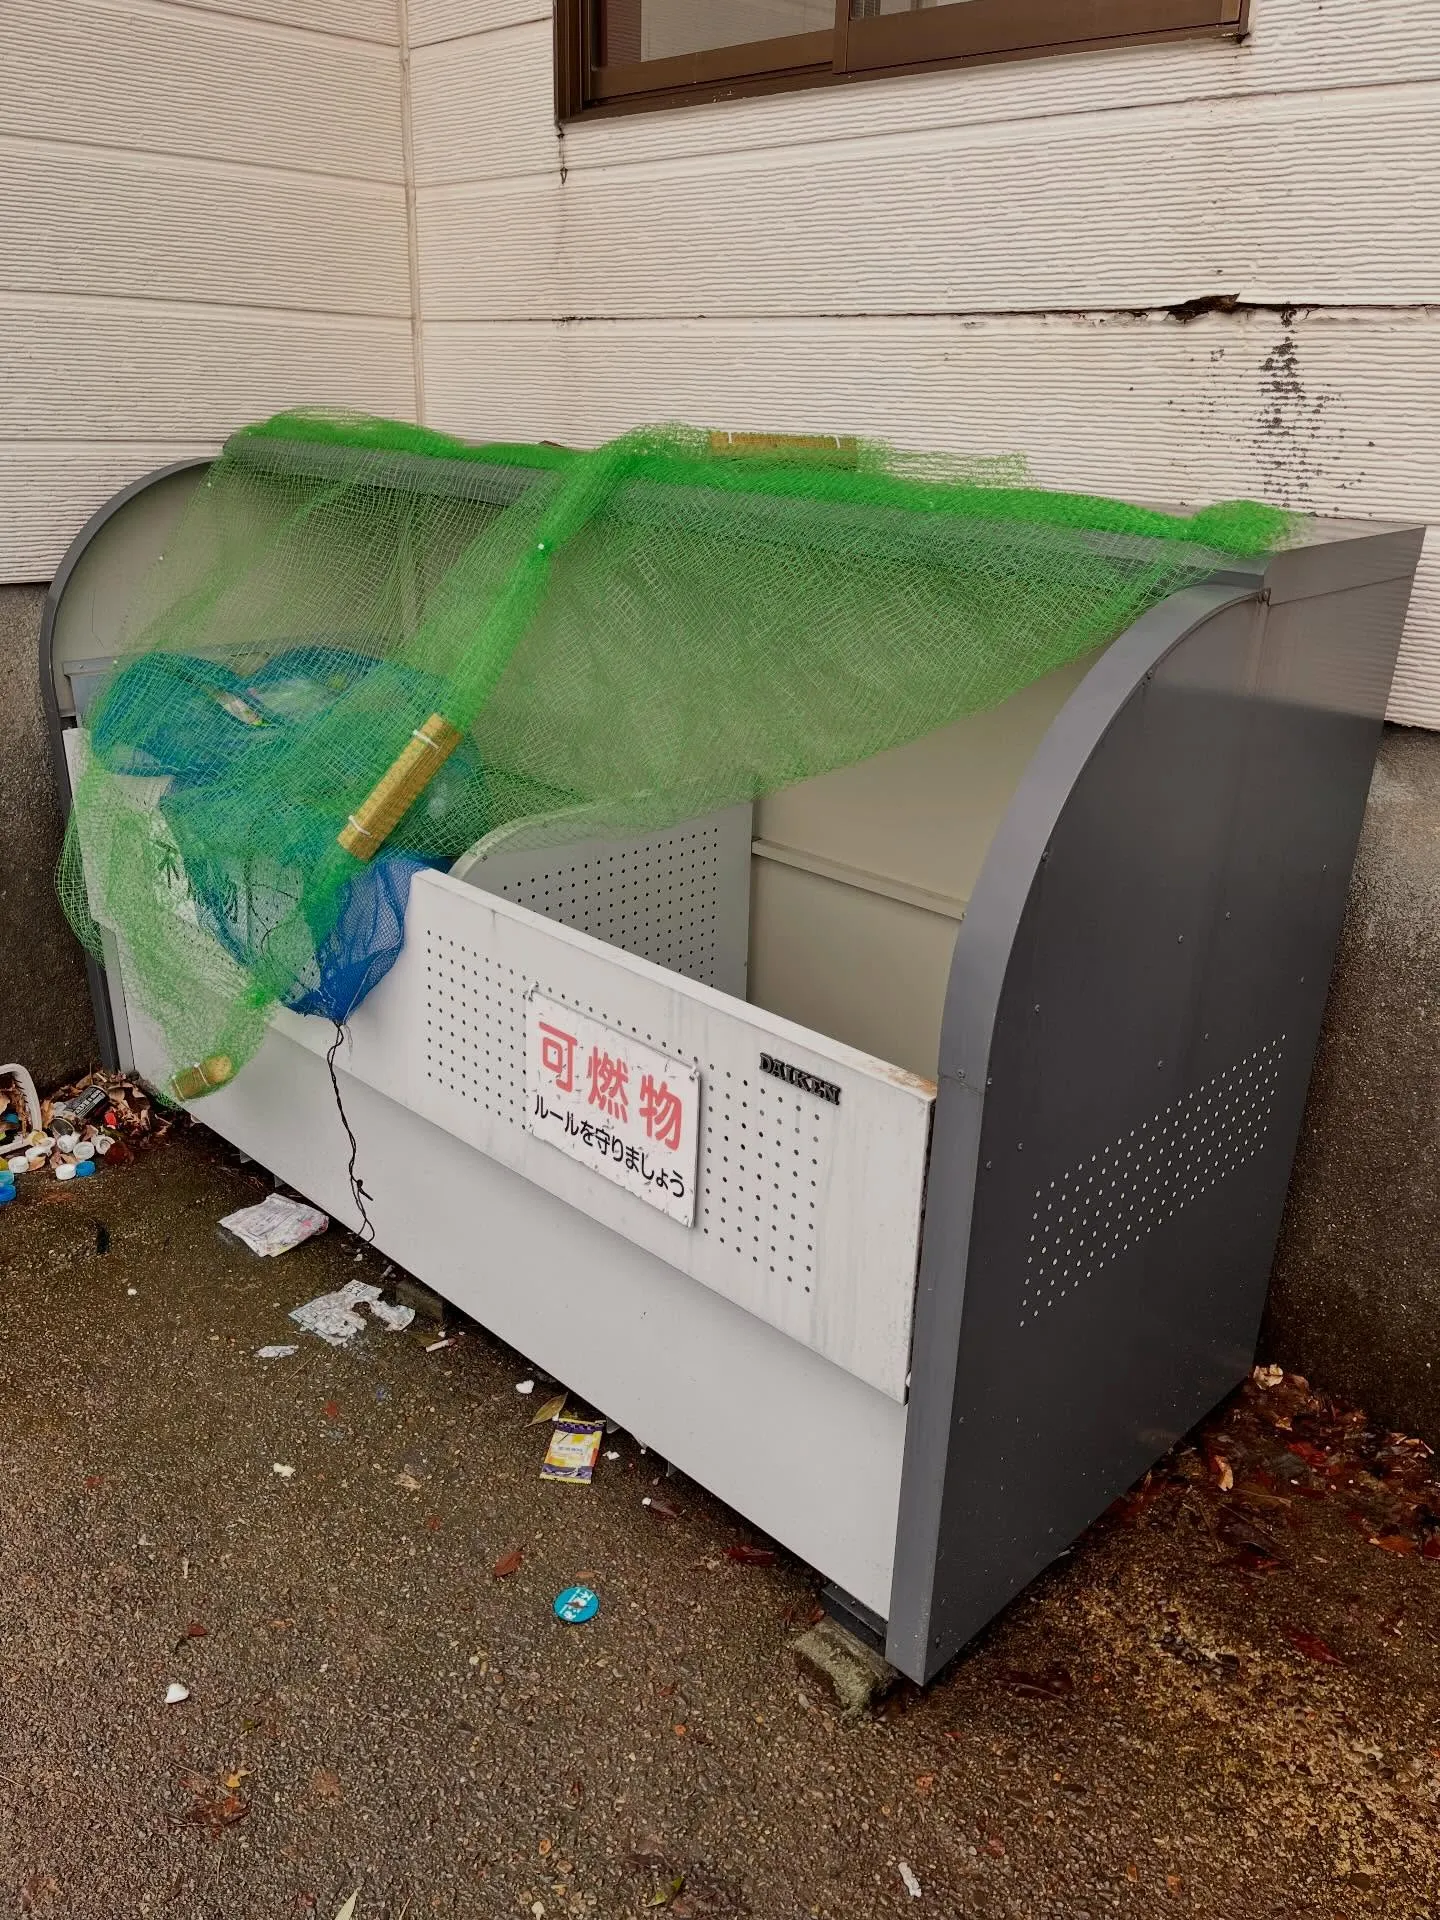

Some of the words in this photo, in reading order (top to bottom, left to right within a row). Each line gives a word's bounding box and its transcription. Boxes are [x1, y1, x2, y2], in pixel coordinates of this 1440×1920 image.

[539, 1021, 683, 1152] 可燃物
[759, 1052, 842, 1106] DAIKEN
[534, 1094, 685, 1199] ルールを守りましょう
